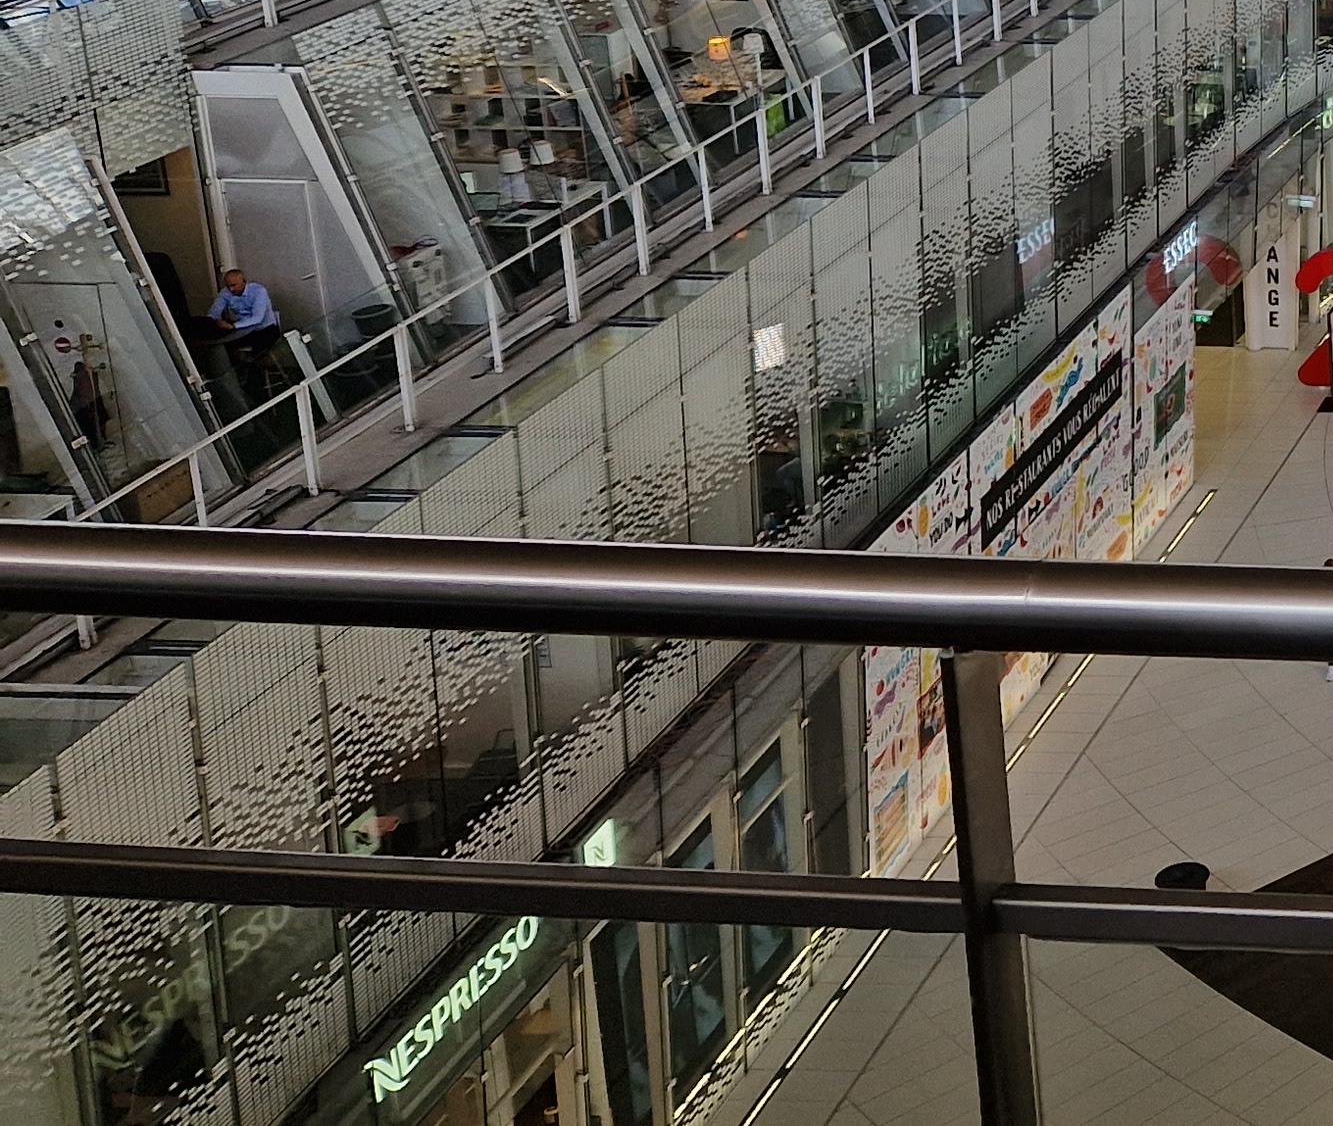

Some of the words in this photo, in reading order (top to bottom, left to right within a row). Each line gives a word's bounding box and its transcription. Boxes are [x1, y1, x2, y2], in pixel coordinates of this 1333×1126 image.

[1163, 220, 1198, 274] ESSEC
[986, 494, 1004, 529] NOS
[1063, 409, 1083, 446] VOUS
[362, 915, 540, 1104] NESPRESSO
